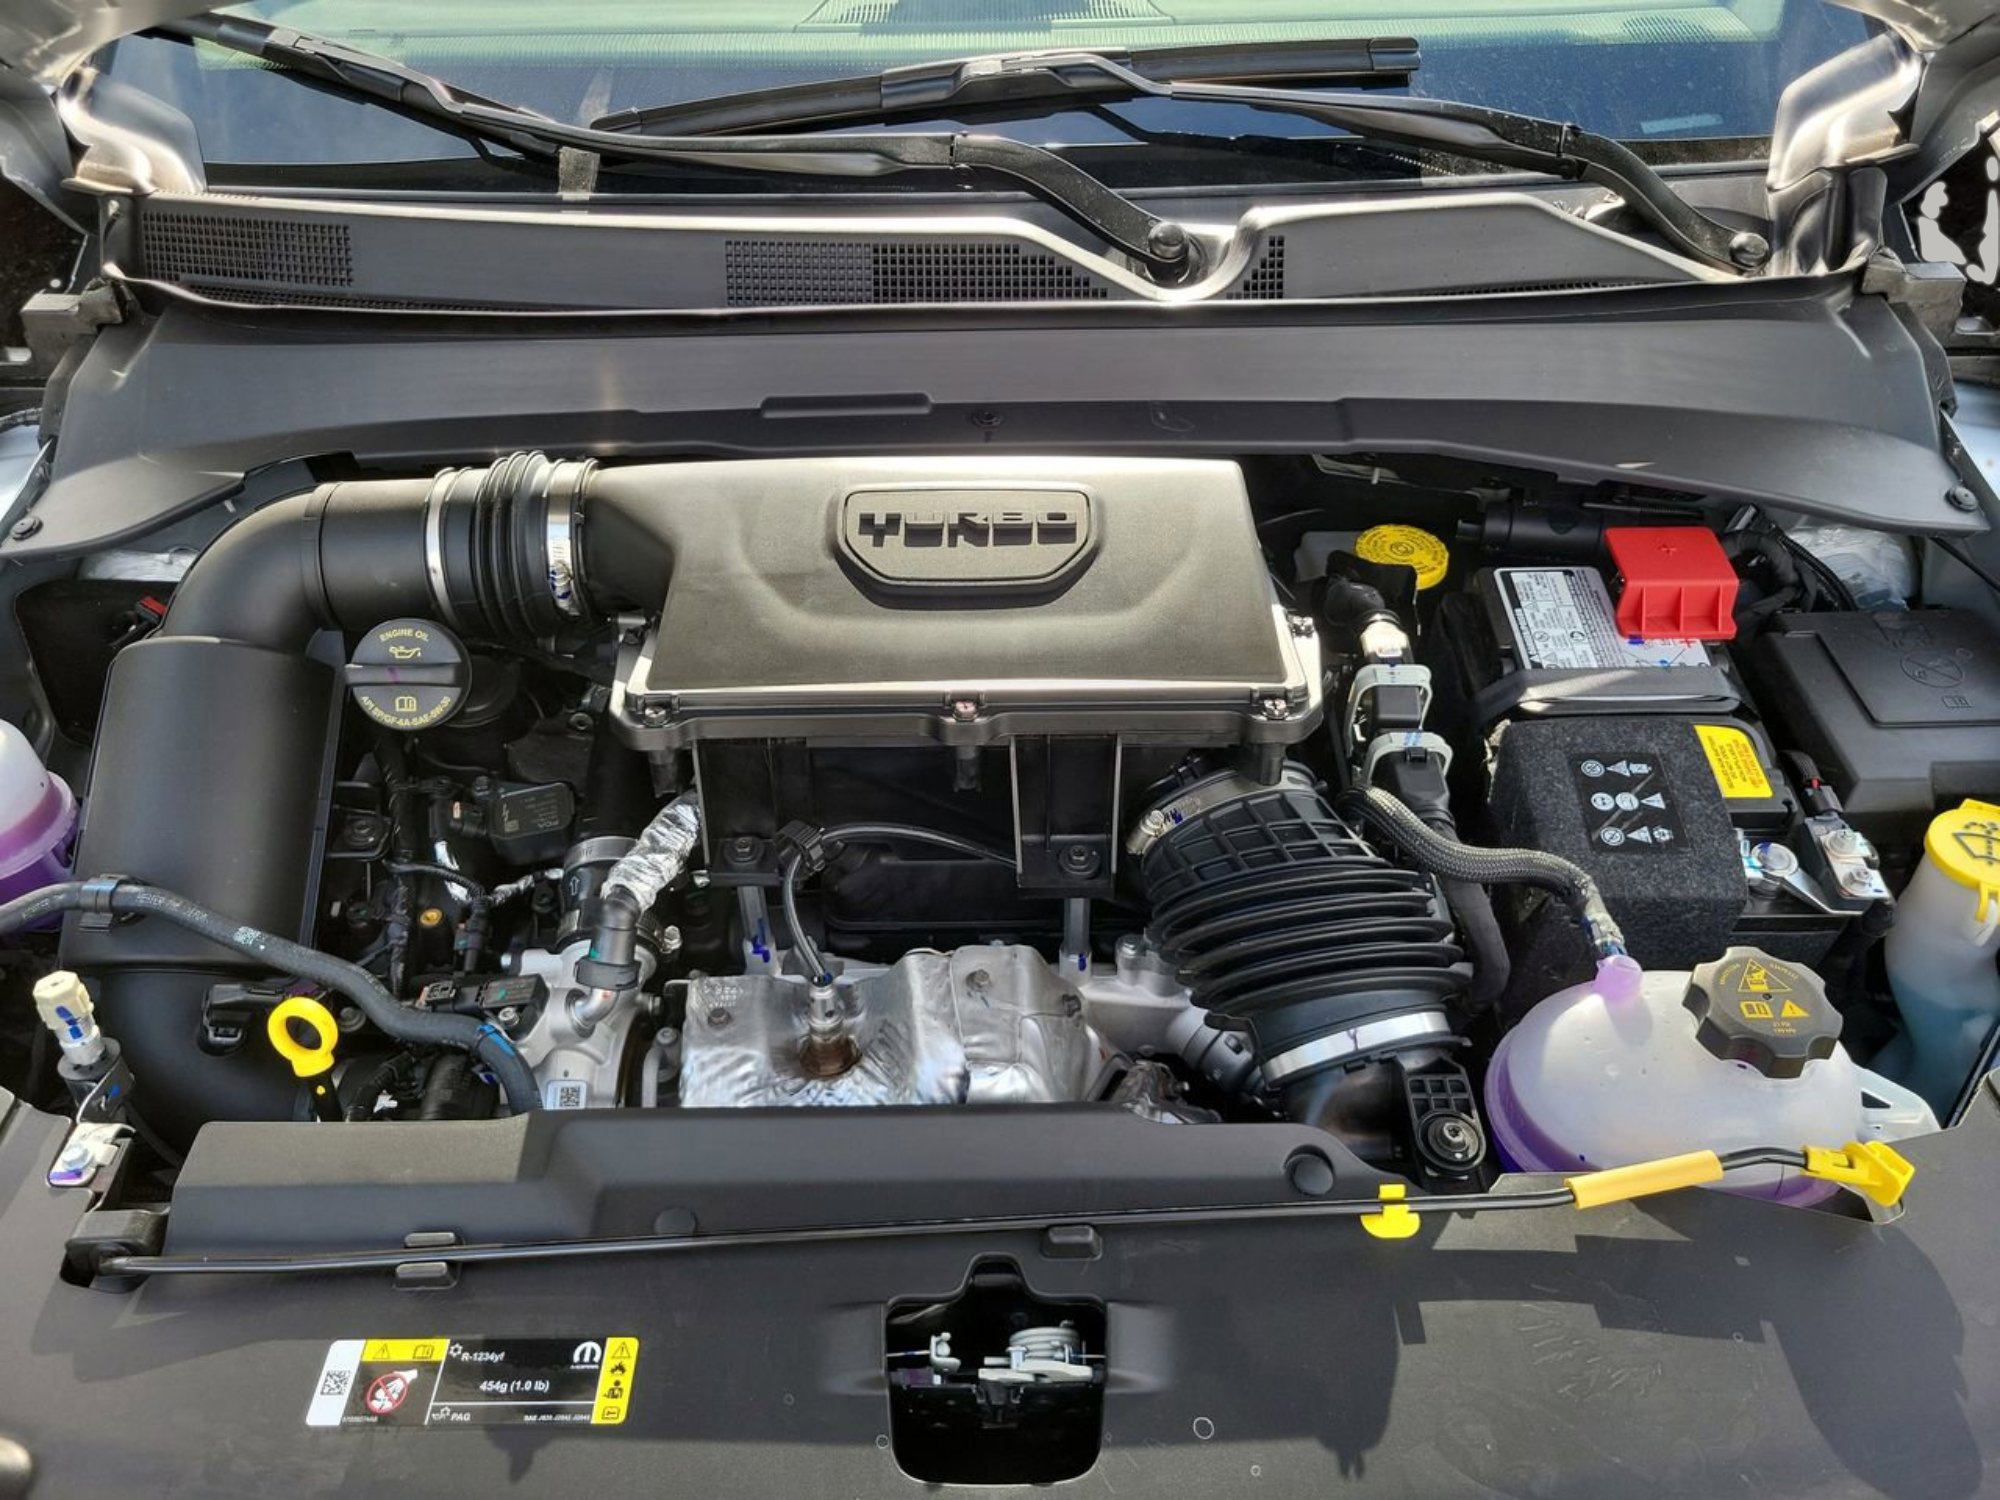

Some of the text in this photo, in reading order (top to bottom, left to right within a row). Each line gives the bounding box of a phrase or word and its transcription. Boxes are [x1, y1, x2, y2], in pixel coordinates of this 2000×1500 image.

[858, 512, 1077, 547] TURBO
[379, 628, 429, 642] ENGINE OIL
[361, 696, 377, 711] API
[460, 1351, 505, 1363] R-1234yf
[479, 1379, 550, 1393] 454g (1.0 lb)
[450, 1412, 471, 1422] PAG
